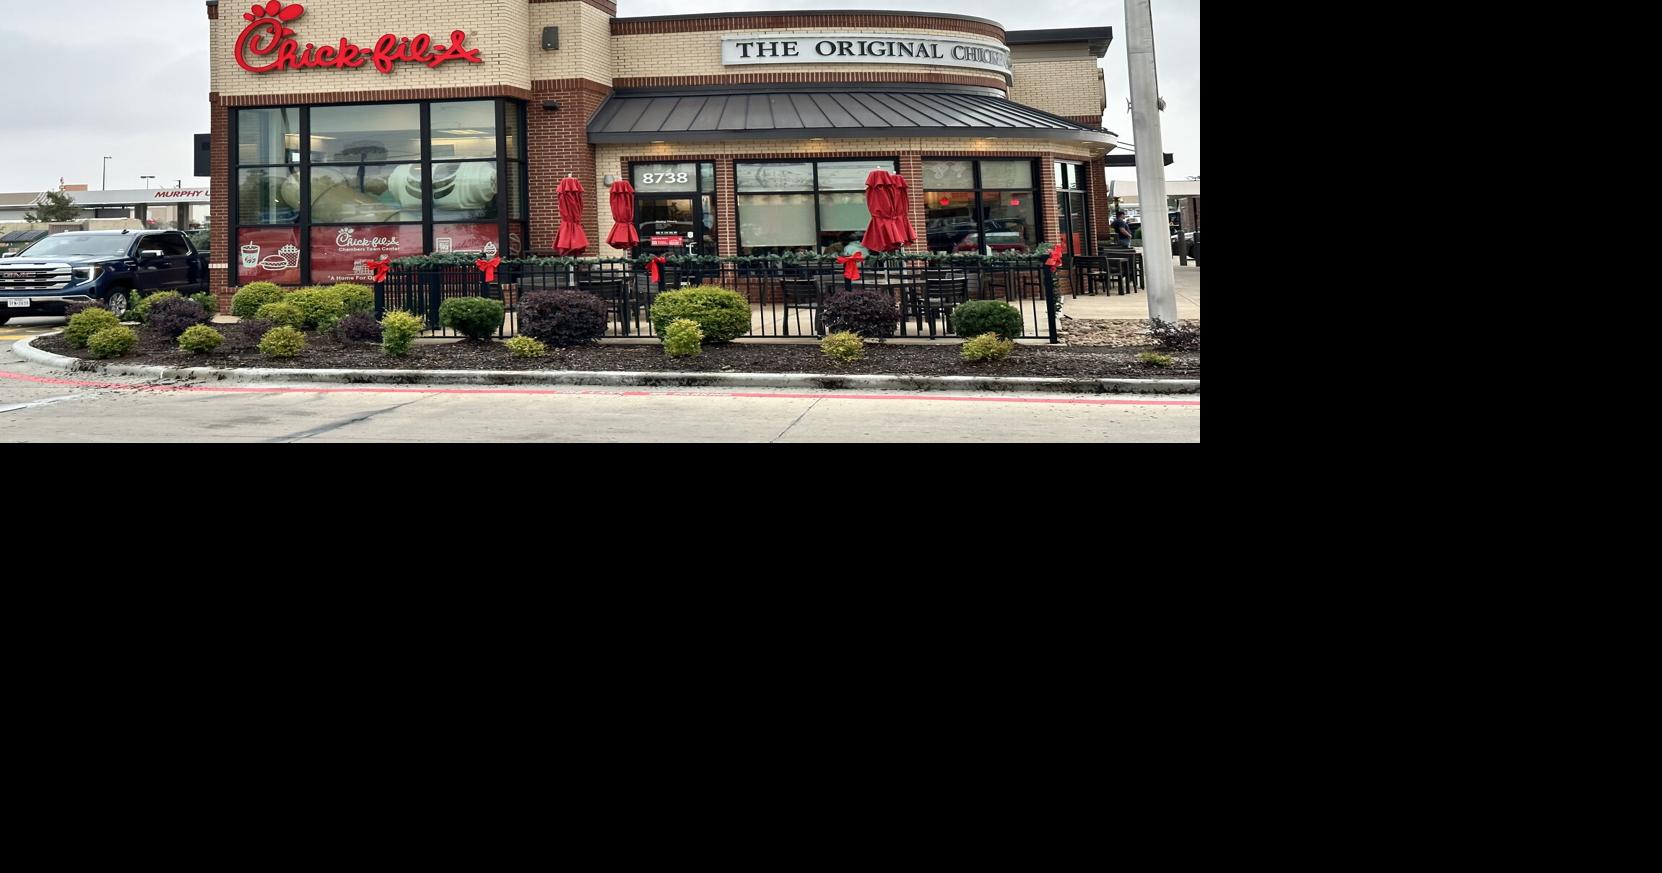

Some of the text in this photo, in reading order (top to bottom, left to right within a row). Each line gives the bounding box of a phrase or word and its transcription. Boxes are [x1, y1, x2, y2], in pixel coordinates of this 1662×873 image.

[234, 1, 483, 73] Chick-fil-A
[735, 41, 799, 58] THE
[815, 40, 944, 60] ORIGINAL
[642, 172, 688, 184] 8738
[154, 190, 203, 198] MURPHY
[336, 227, 399, 246] Chick-fil-A
